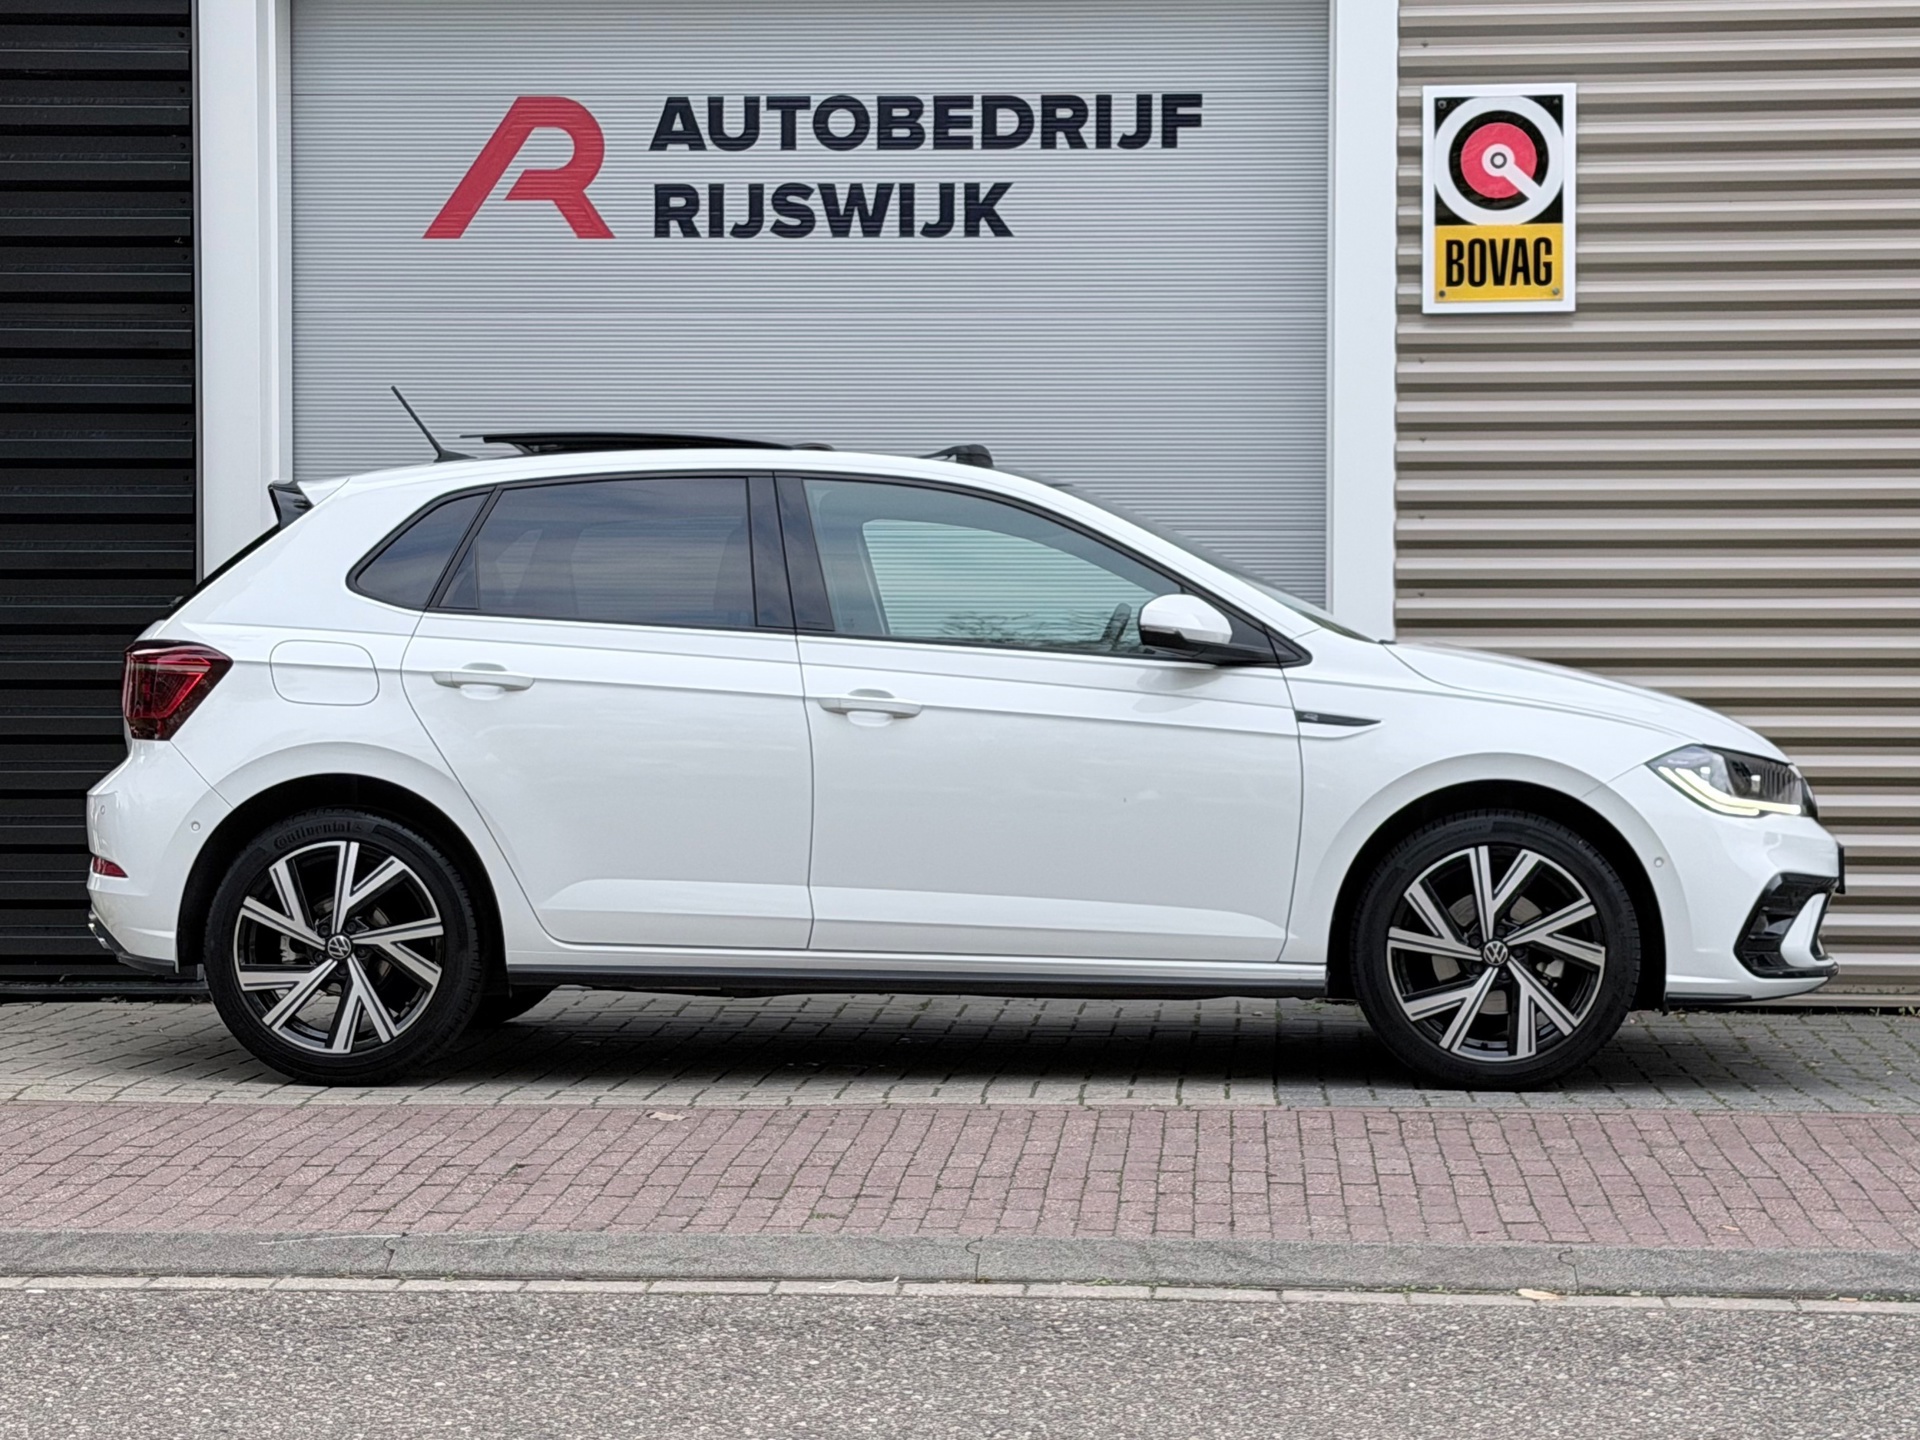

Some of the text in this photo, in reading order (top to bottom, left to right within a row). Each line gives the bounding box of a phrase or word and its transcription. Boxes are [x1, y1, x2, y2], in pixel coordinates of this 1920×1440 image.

[649, 93, 1203, 151] AUTOBEDRIJF
[654, 181, 1014, 239] RIJSWIJK
[1445, 237, 1553, 287] BOVAG
[274, 821, 350, 848] Continental
